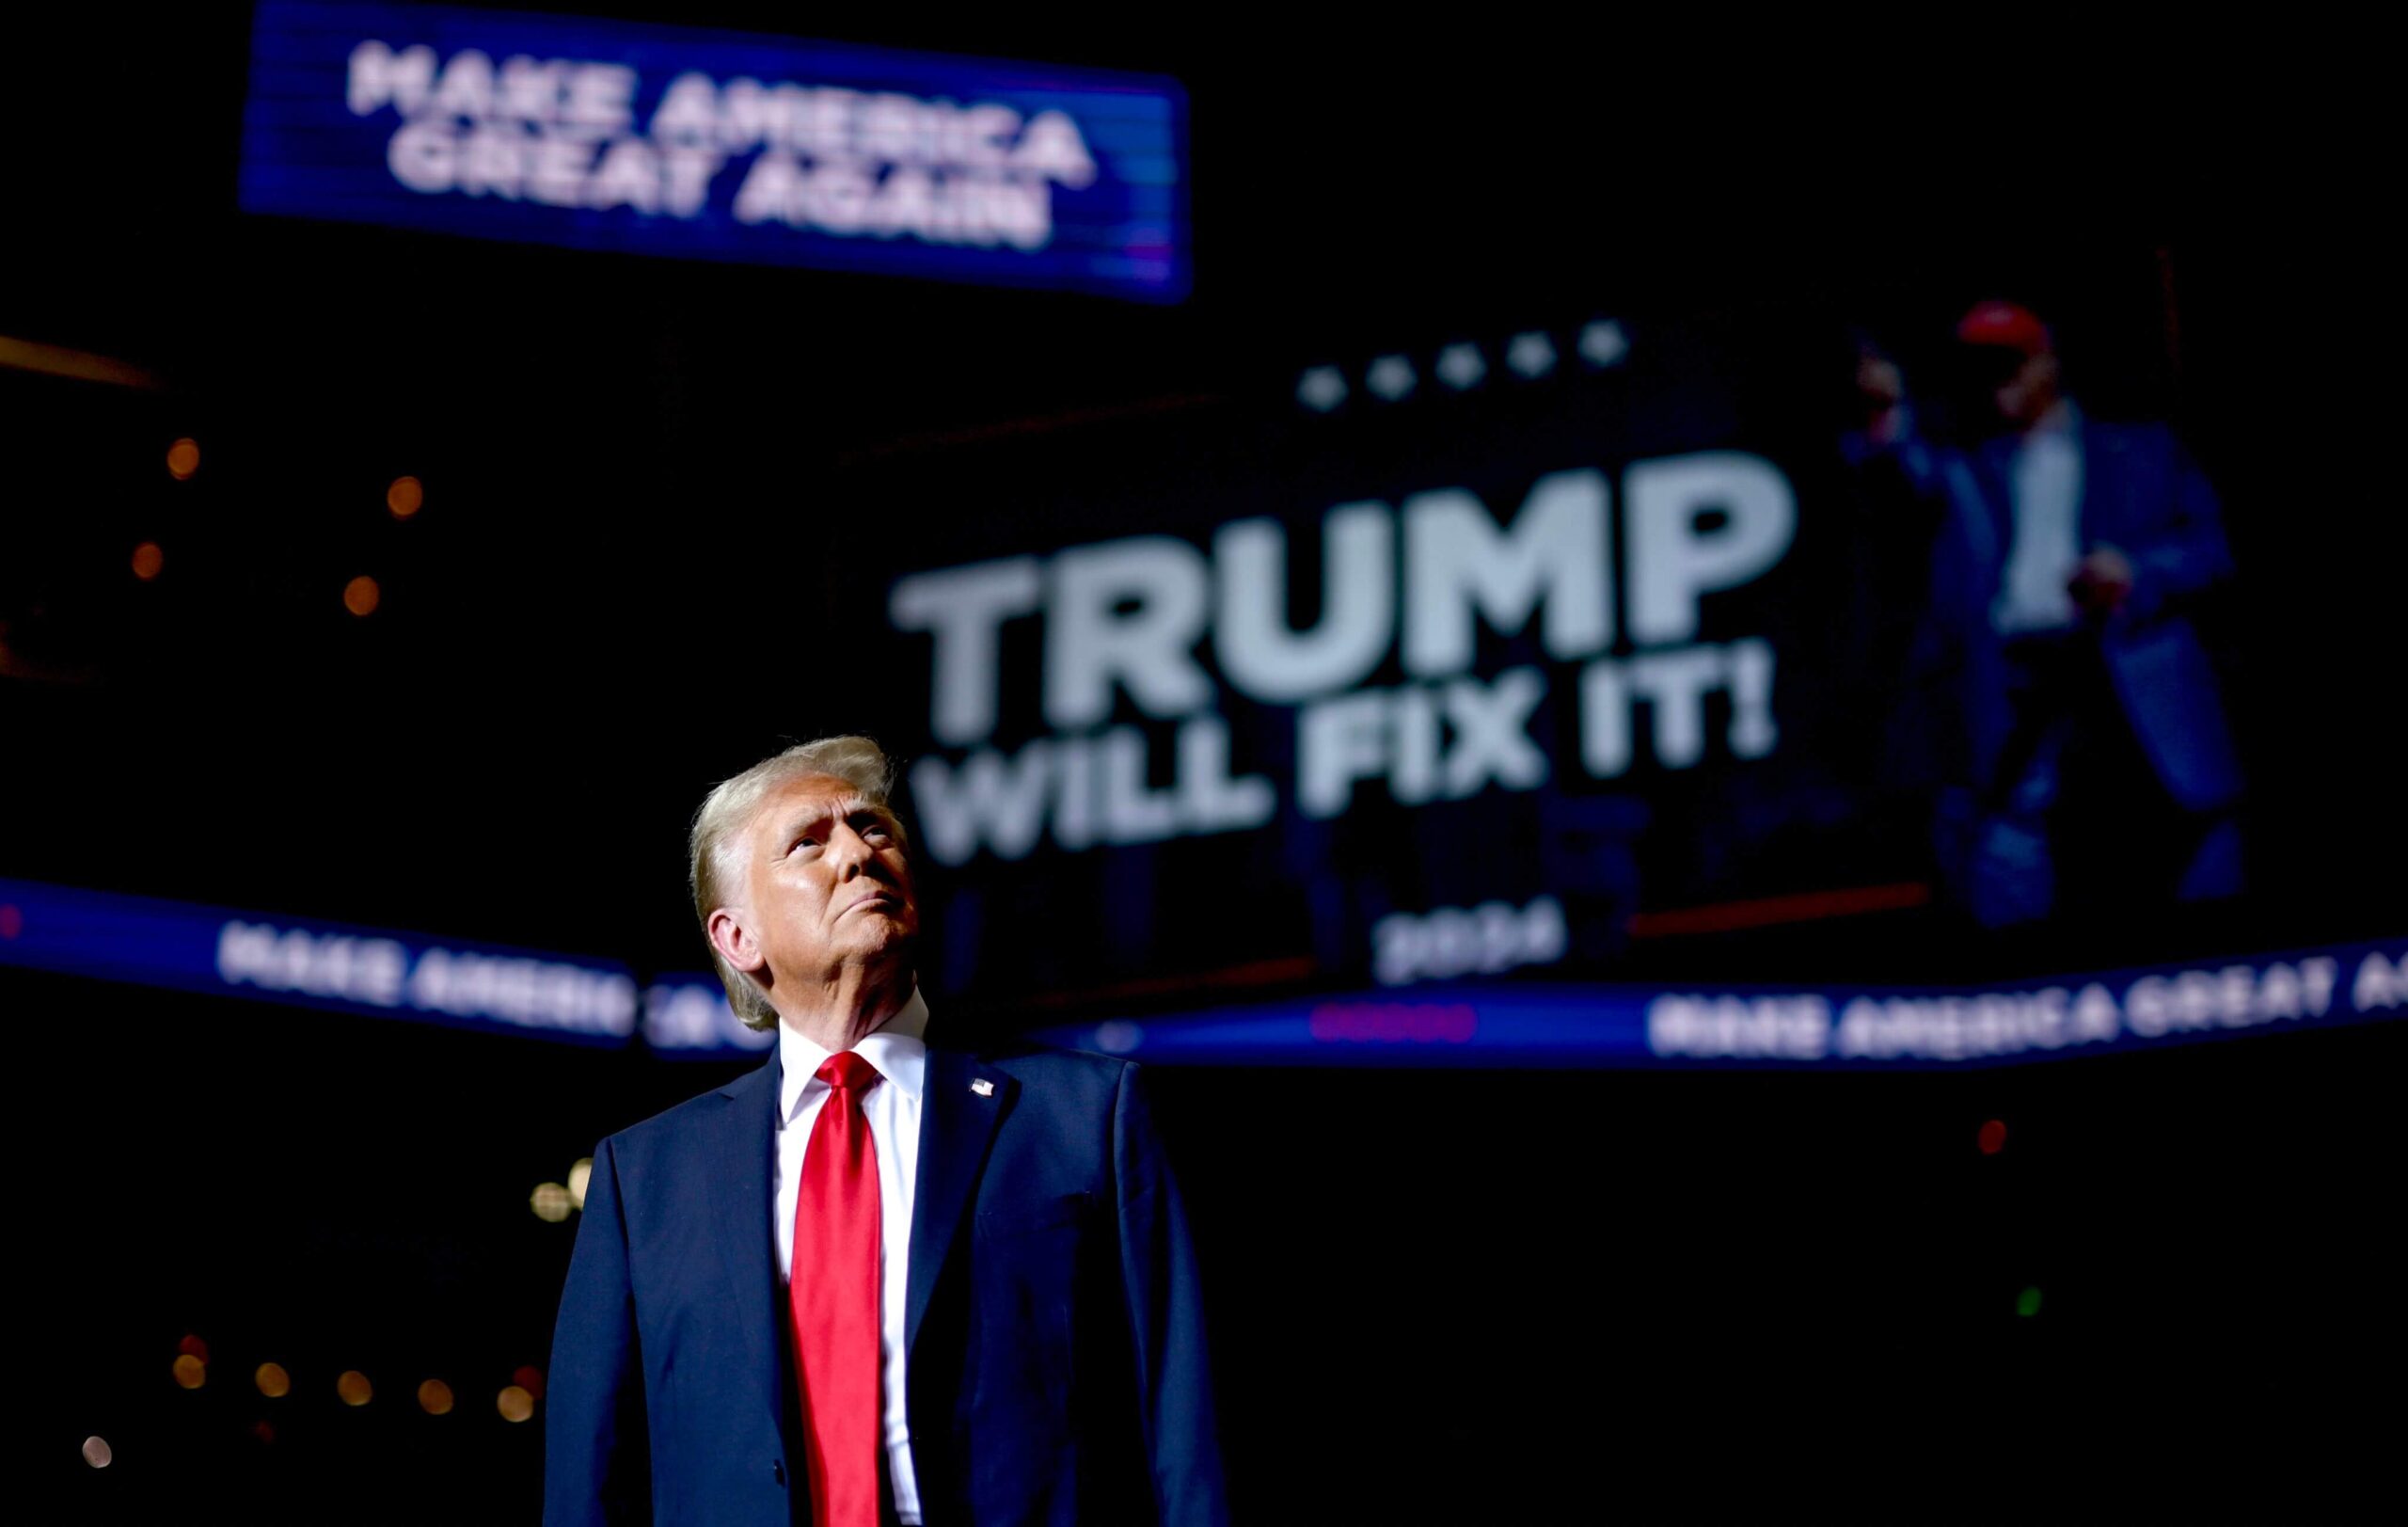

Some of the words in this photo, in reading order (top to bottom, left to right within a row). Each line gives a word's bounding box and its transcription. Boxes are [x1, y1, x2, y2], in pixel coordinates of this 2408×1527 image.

[349, 41, 639, 130] MAKE
[650, 73, 1097, 187] AMERICA
[388, 115, 719, 217] GREAT
[733, 151, 1052, 251] AGAIN
[892, 450, 1797, 745] TRUMP
[911, 720, 1275, 865] WILL
[1297, 666, 1547, 818] FIX
[1580, 638, 1775, 776] IT!
[217, 919, 405, 1005] MAKE
[1646, 994, 1829, 1058] MAKE
[1838, 983, 2119, 1059] AMERICA
[2124, 955, 2337, 1038] GREAT
[2353, 950, 2408, 1012] A
